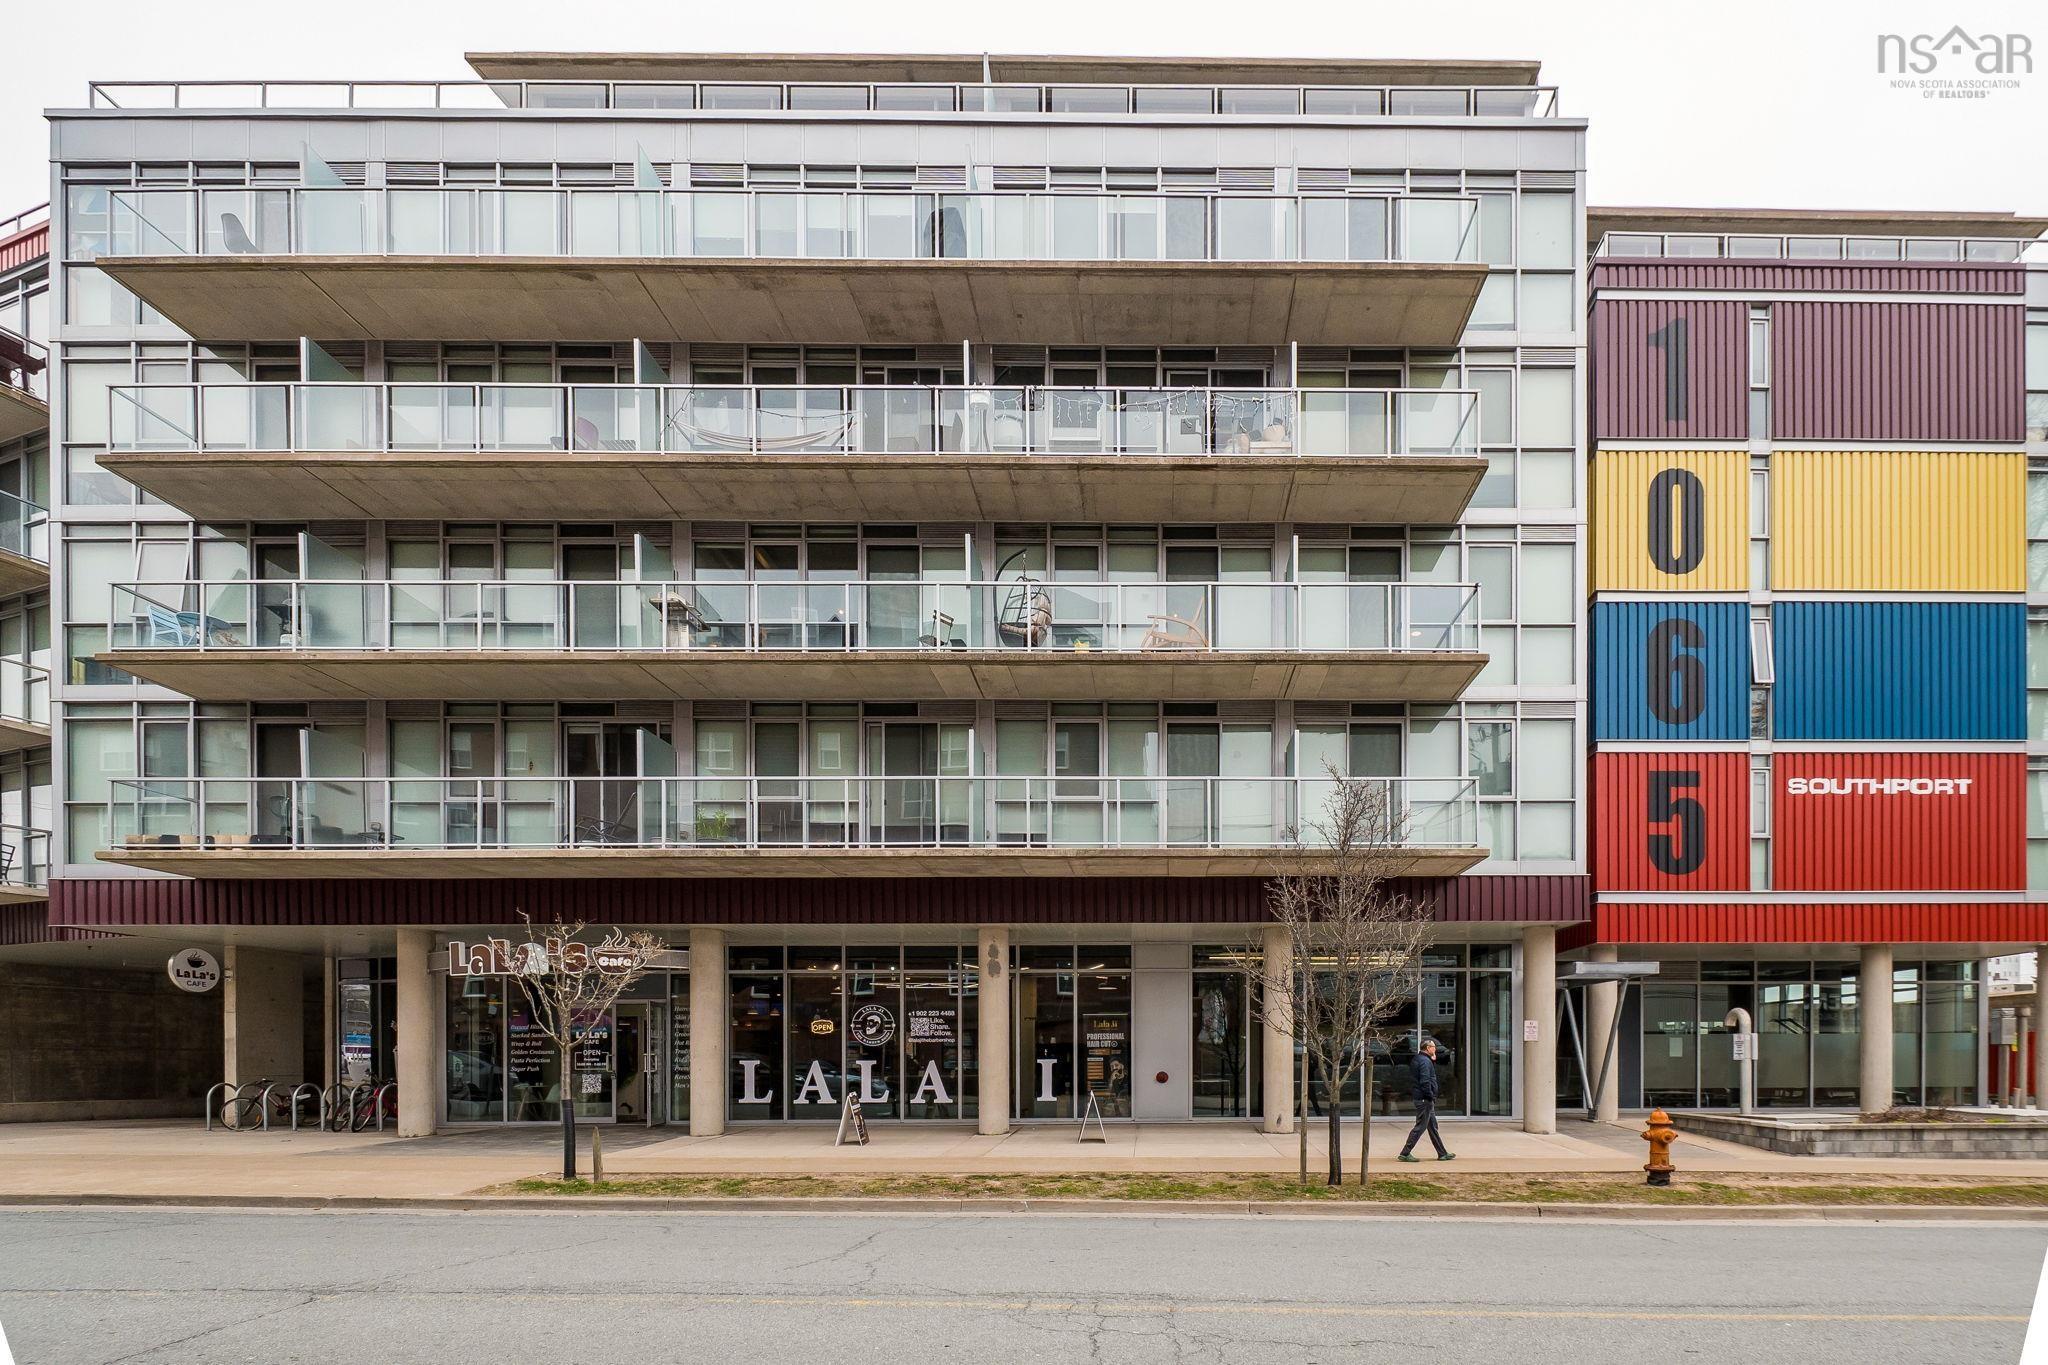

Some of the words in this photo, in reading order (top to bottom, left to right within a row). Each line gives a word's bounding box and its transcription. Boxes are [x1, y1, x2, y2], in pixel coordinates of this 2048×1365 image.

[1787, 777, 1973, 795] SOUTHPORT
[192, 969, 216, 981] La's
[186, 980, 207, 988] CAFE
[1086, 1032, 1125, 1041] PROFESSIONAL
[1086, 1040, 1100, 1048] HAIR
